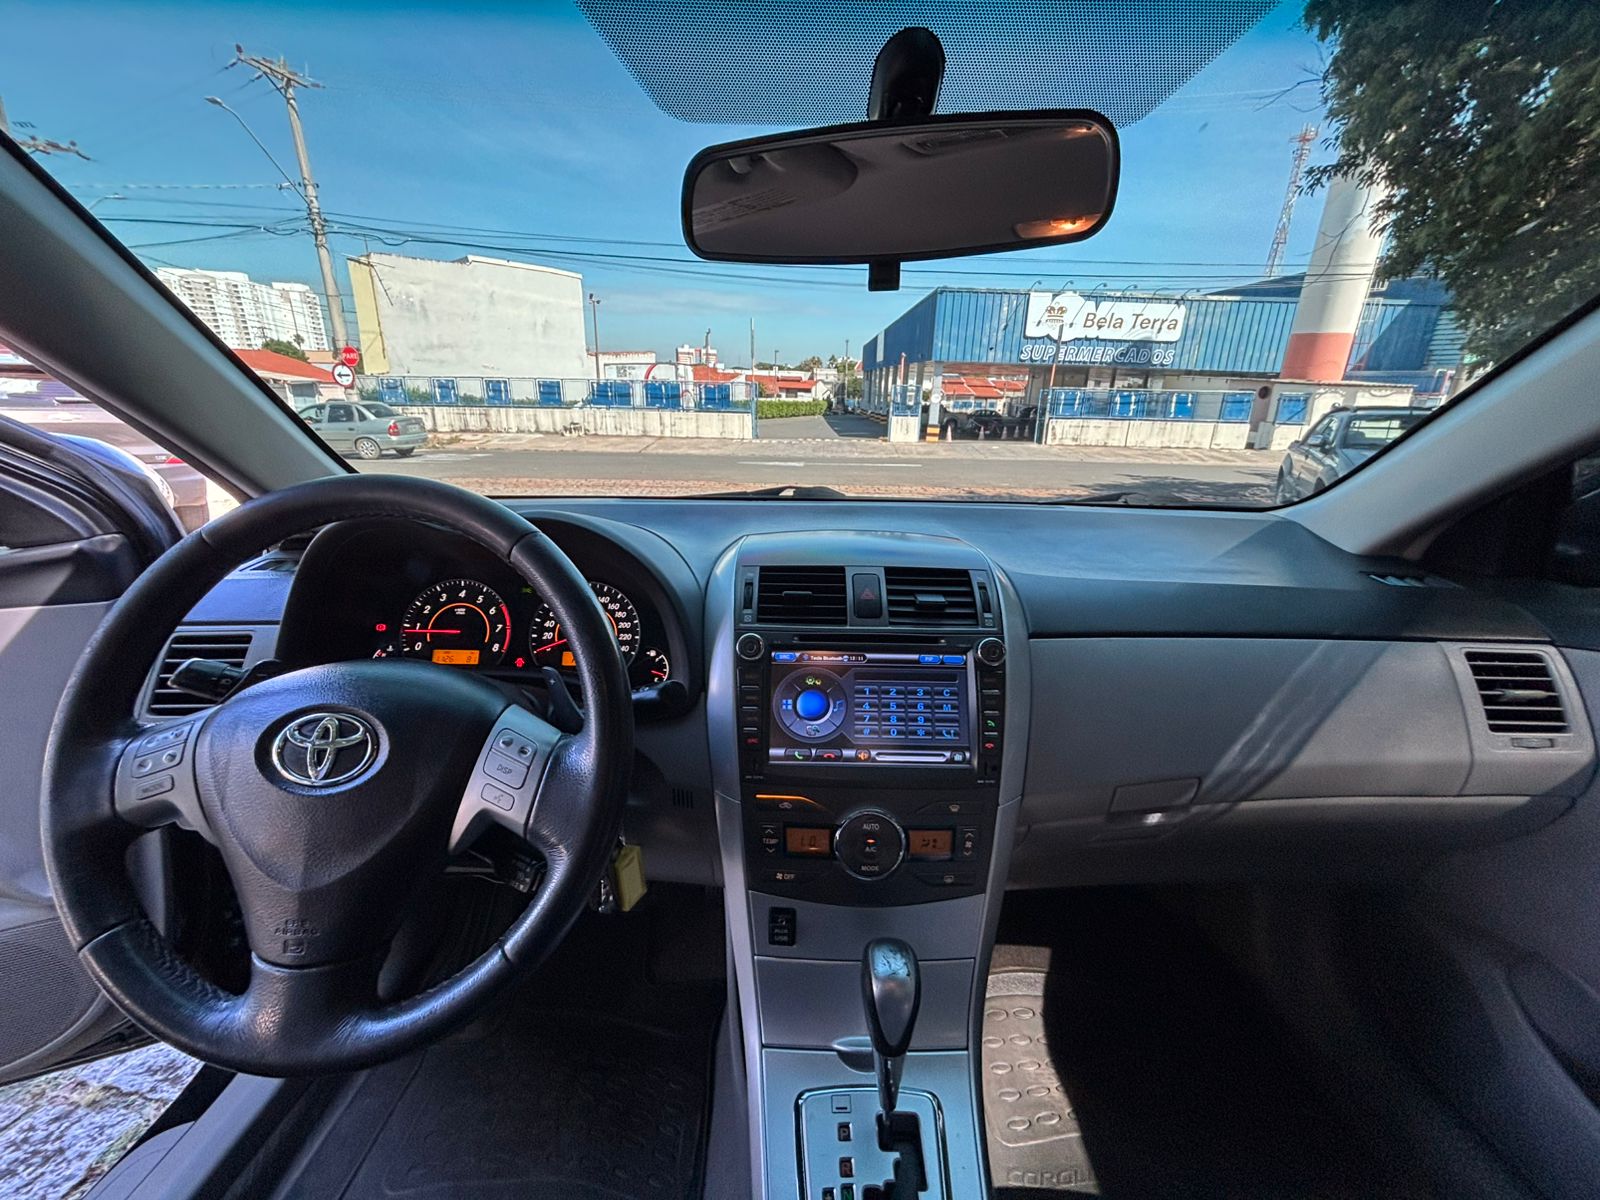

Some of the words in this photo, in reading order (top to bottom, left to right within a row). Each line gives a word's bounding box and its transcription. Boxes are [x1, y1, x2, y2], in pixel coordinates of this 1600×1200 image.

[1083, 312, 1124, 330] Bela
[1131, 313, 1179, 331] Terra
[1020, 344, 1176, 365] SUPERMERCADOS
[440, 593, 447, 602] 3
[459, 589, 467, 598] 4
[476, 595, 484, 603] 5
[423, 606, 431, 614] 2
[489, 607, 496, 615] 6
[495, 624, 503, 633] 7
[618, 622, 631, 630] 200
[542, 632, 554, 640] 20
[618, 633, 632, 641] 220
[415, 642, 422, 651] 0
[492, 643, 500, 652] 8
[863, 687, 870, 696] 1
[889, 688, 897, 697] 2
[916, 688, 924, 697] 3
[943, 689, 951, 697] C
[863, 702, 870, 711] 4
[889, 703, 897, 711] 5
[917, 703, 924, 712] 6
[863, 714, 870, 723] 7
[889, 715, 897, 724] 8
[917, 716, 925, 724] 9
[890, 728, 897, 737] 0
[496, 764, 513, 775] DISP
[862, 823, 880, 831] AUTO
[861, 864, 880, 872] MODE
[784, 872, 796, 880] OFF
[840, 1128, 849, 1140] P
